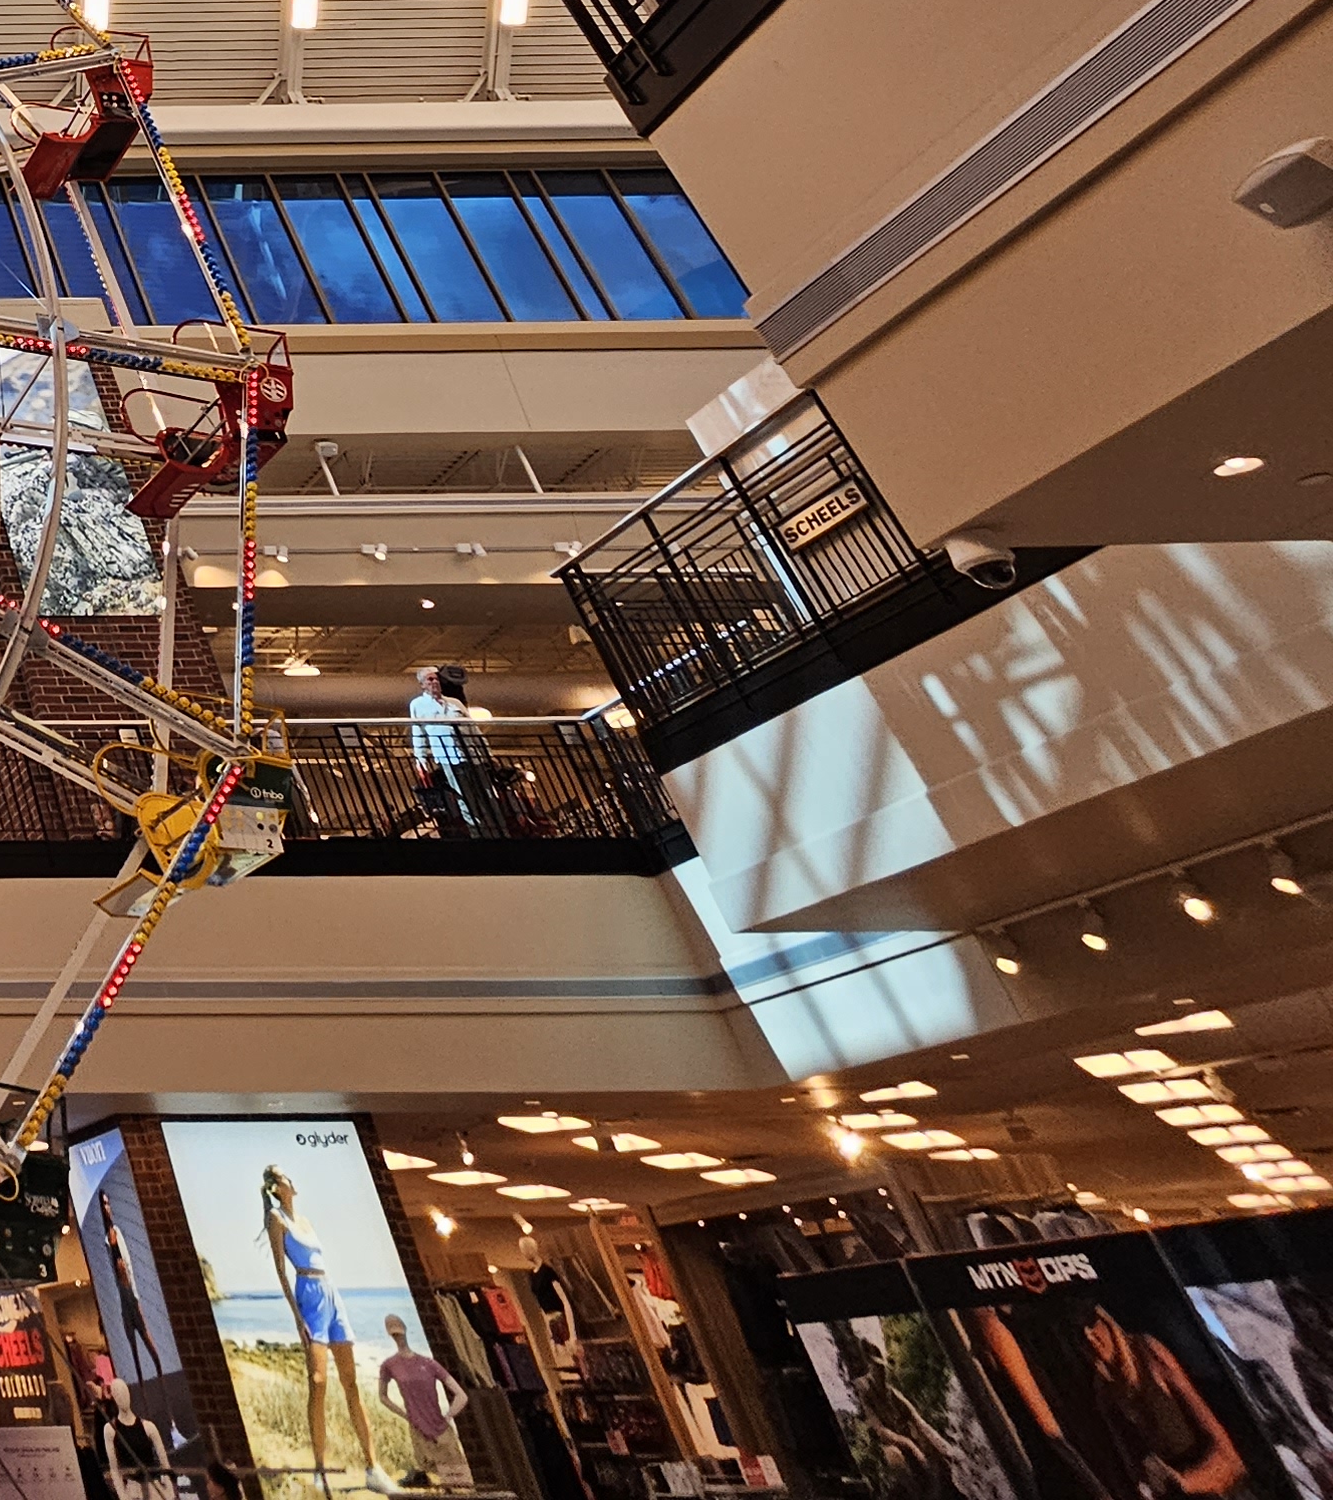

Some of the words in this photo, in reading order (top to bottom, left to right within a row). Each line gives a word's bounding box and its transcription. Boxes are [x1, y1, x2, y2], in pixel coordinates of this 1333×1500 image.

[783, 487, 862, 544] SCHEELS
[266, 838, 274, 849] 2
[307, 1130, 349, 1149] glyder
[39, 1263, 48, 1278] 3
[966, 1261, 1023, 1290] MTN
[1036, 1253, 1099, 1284] OPS
